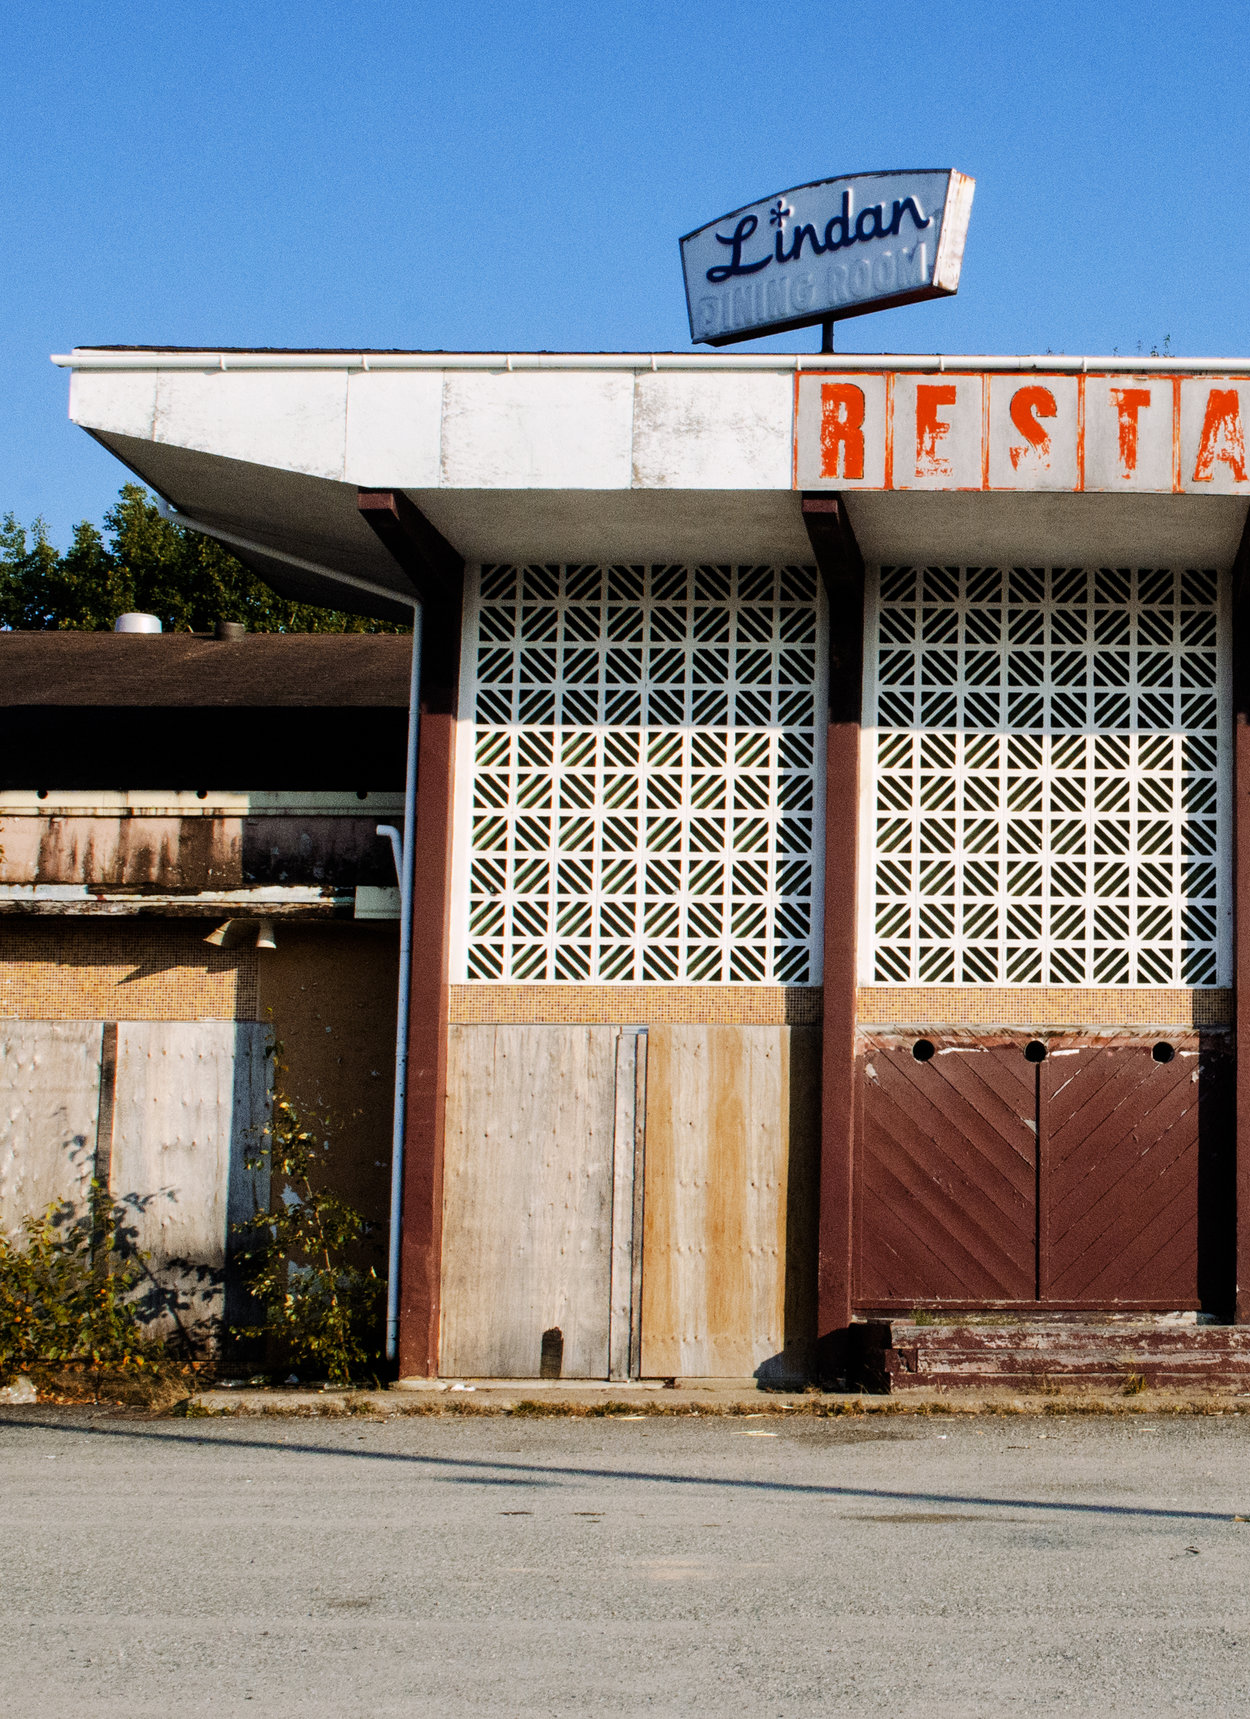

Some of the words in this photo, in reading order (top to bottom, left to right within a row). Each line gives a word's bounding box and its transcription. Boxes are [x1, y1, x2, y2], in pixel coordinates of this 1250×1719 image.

[706, 188, 931, 283] Lindan
[699, 270, 815, 331] DINING
[826, 241, 929, 304] ROOM
